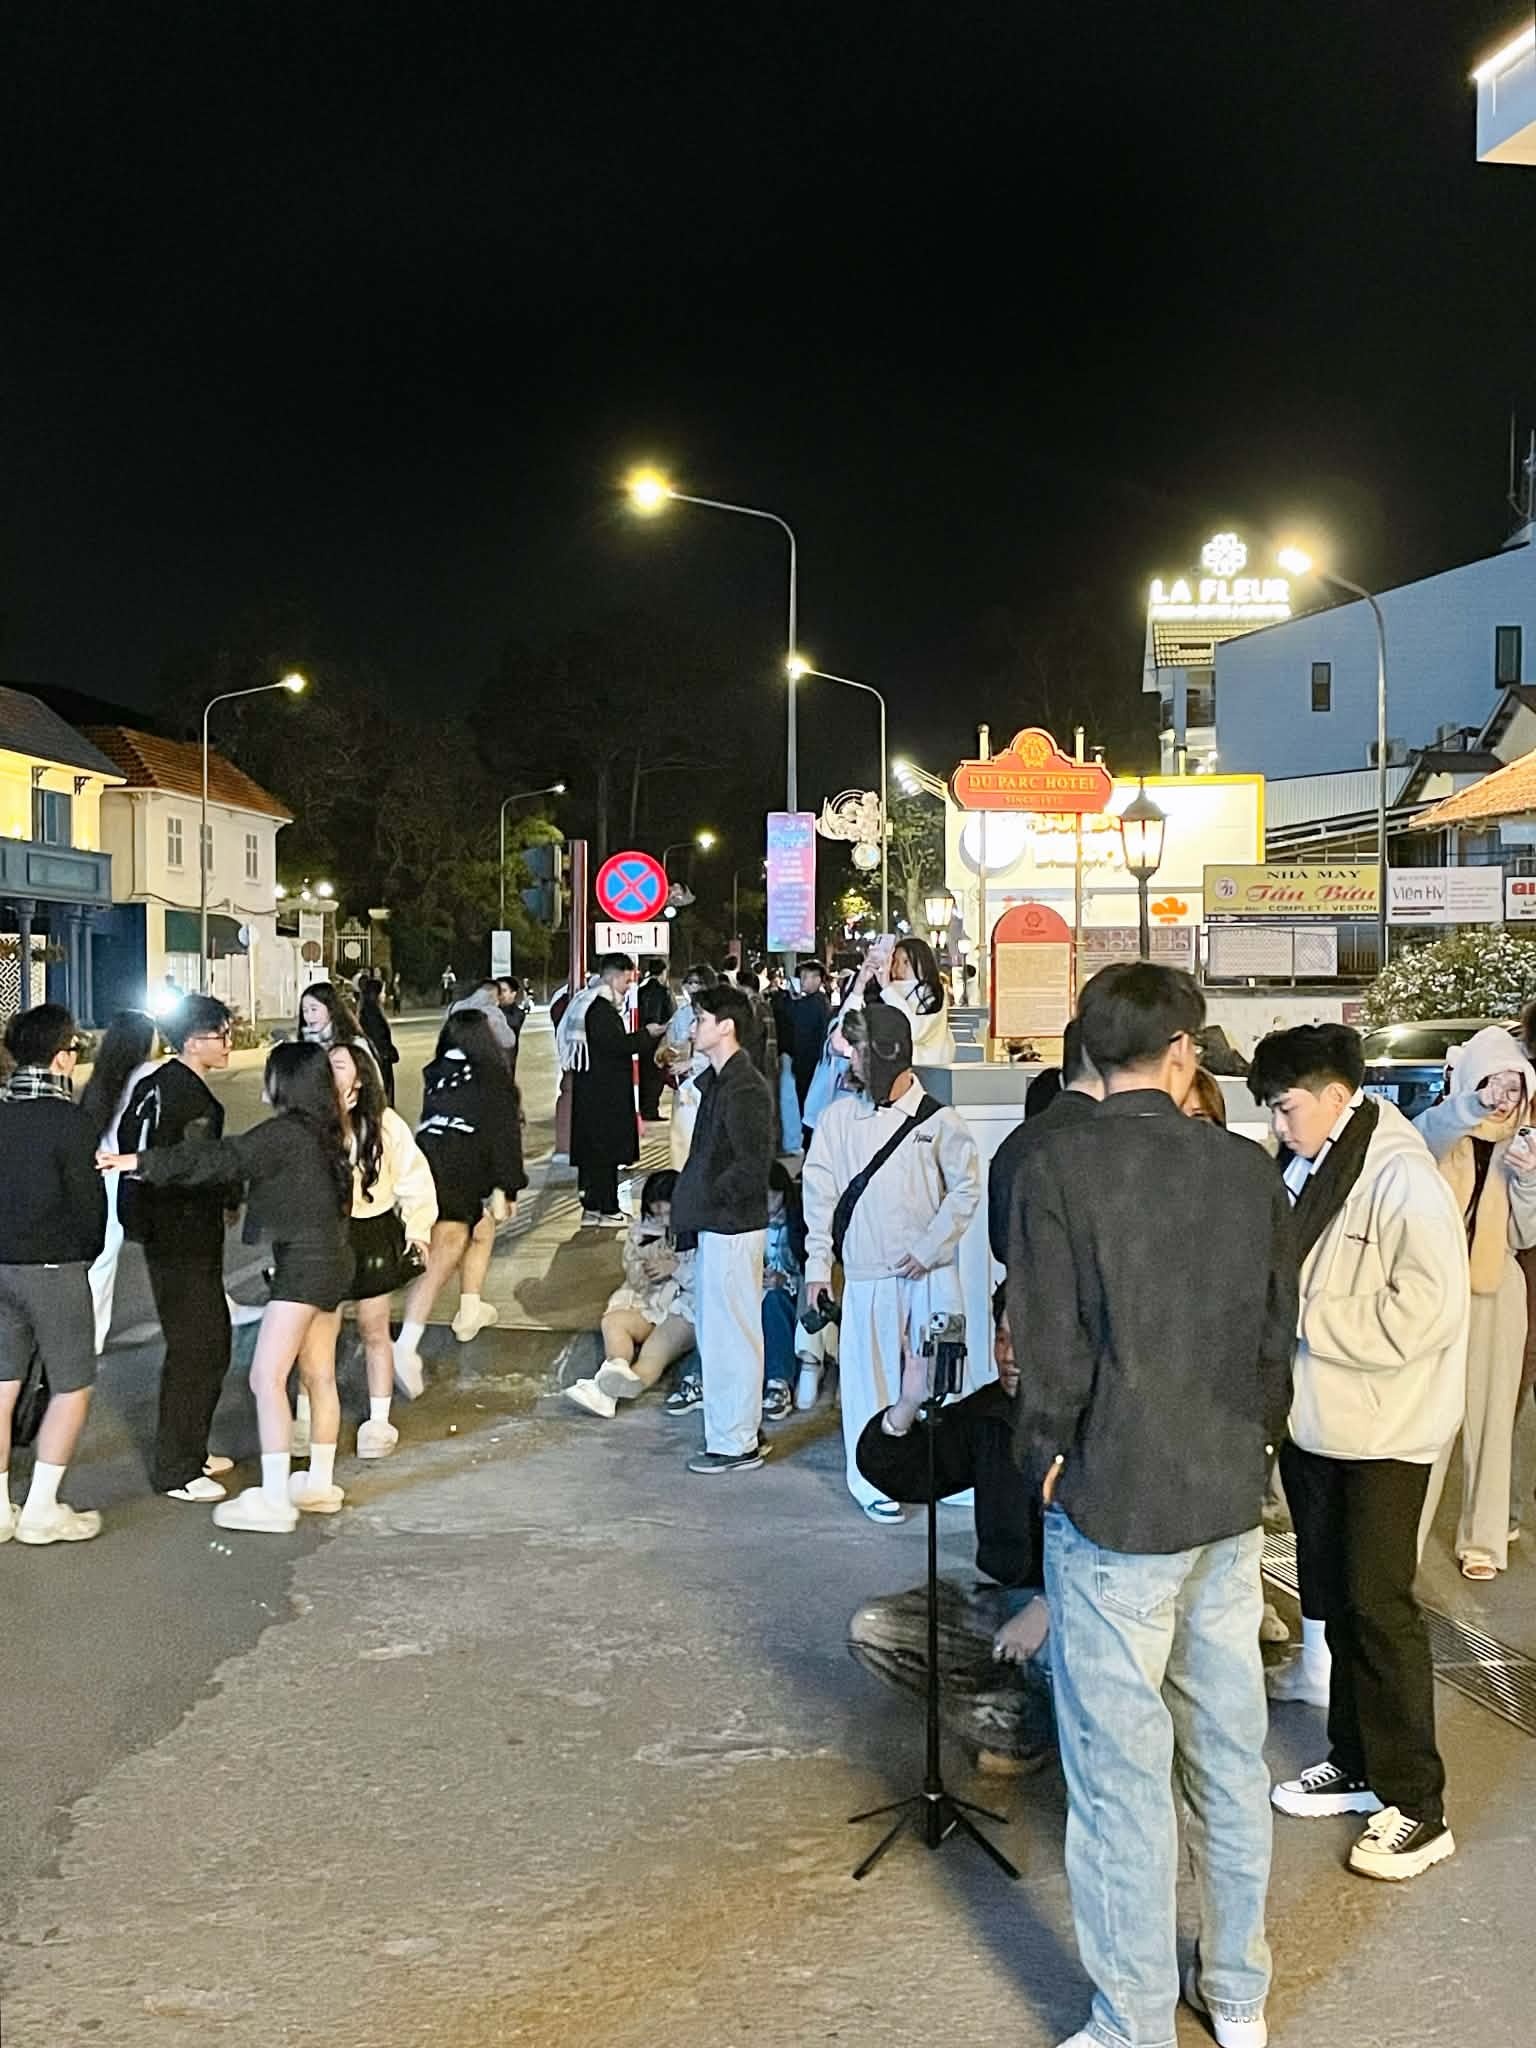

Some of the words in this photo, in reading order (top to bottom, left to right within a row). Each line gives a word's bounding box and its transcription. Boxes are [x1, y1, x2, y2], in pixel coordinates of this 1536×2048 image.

[1150, 579, 1193, 603] LA
[1199, 578, 1289, 603] FLEUR
[968, 775, 992, 788] DU
[995, 775, 1040, 789] PARC
[1045, 775, 1097, 790] HOTEL
[616, 932, 643, 944] 100m
